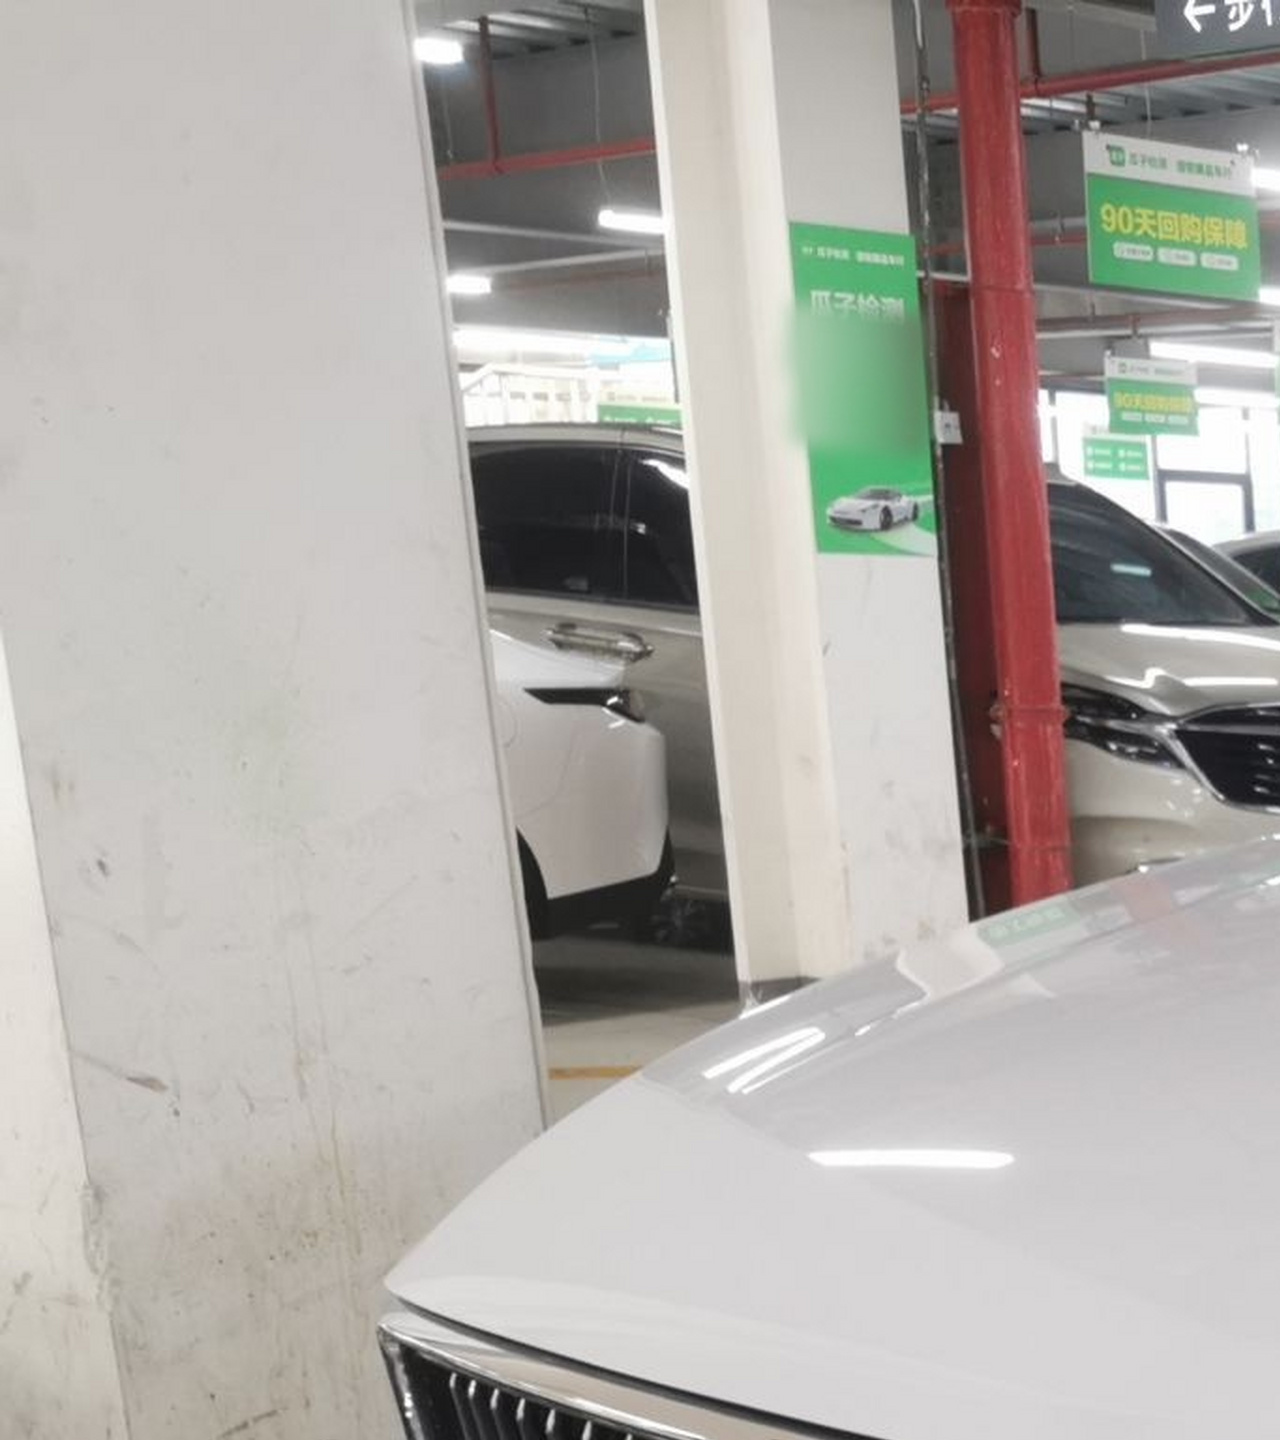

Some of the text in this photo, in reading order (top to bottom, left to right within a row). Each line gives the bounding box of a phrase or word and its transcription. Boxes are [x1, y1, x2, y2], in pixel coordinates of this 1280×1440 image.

[1100, 203, 1249, 249] 90天回购保障
